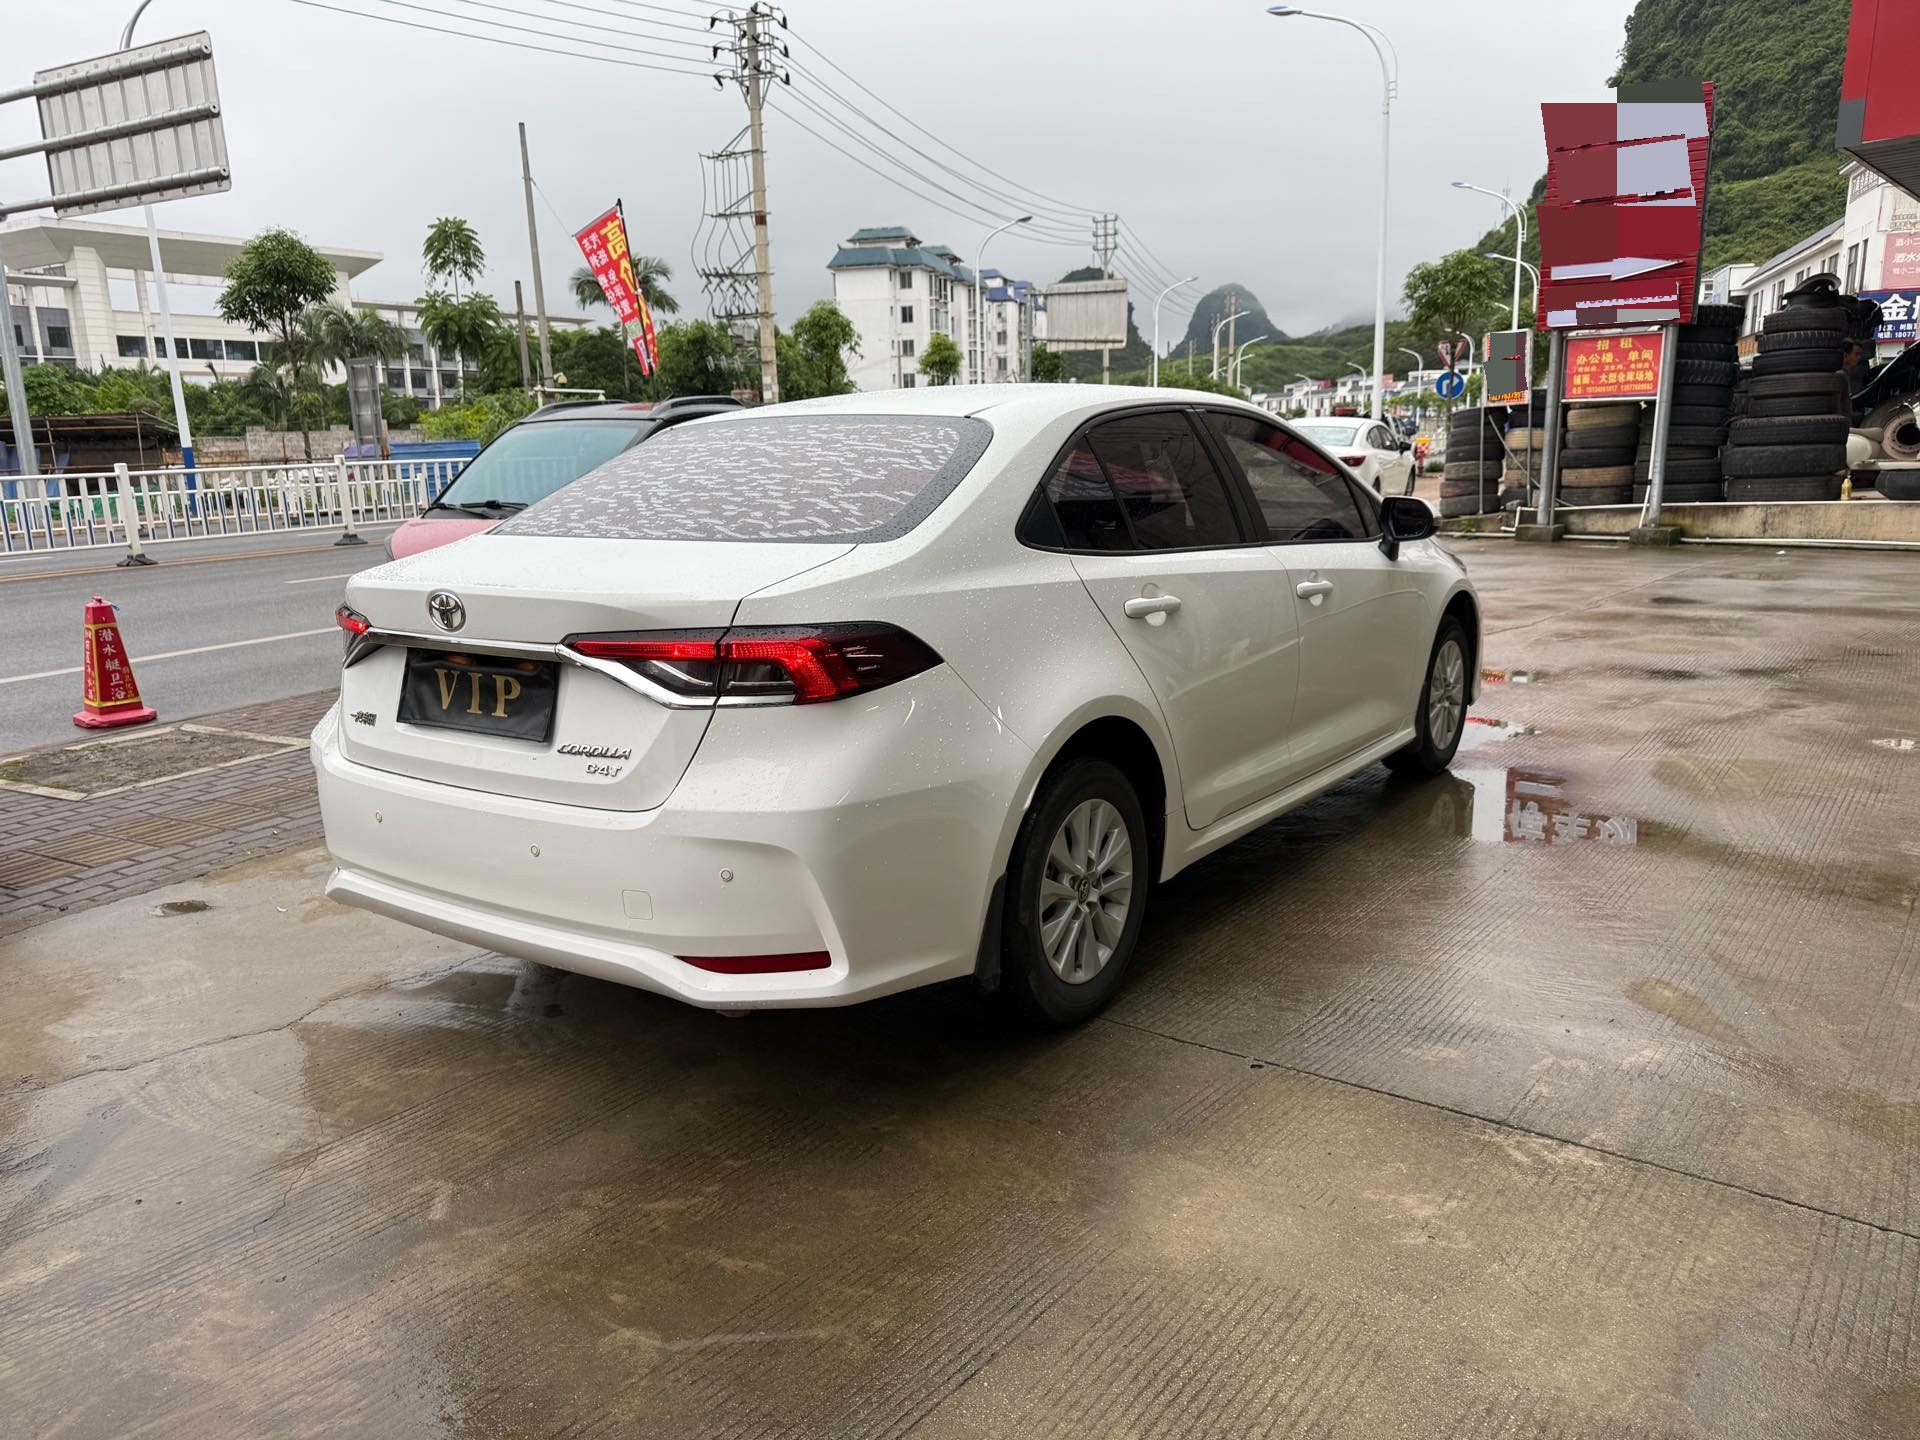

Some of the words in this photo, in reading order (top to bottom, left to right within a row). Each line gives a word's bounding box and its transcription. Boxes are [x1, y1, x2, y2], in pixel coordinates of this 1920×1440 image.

[98, 628, 126, 700] 潜水艇卫浴
[434, 668, 521, 718] VIP
[557, 744, 632, 760] COROLLA
